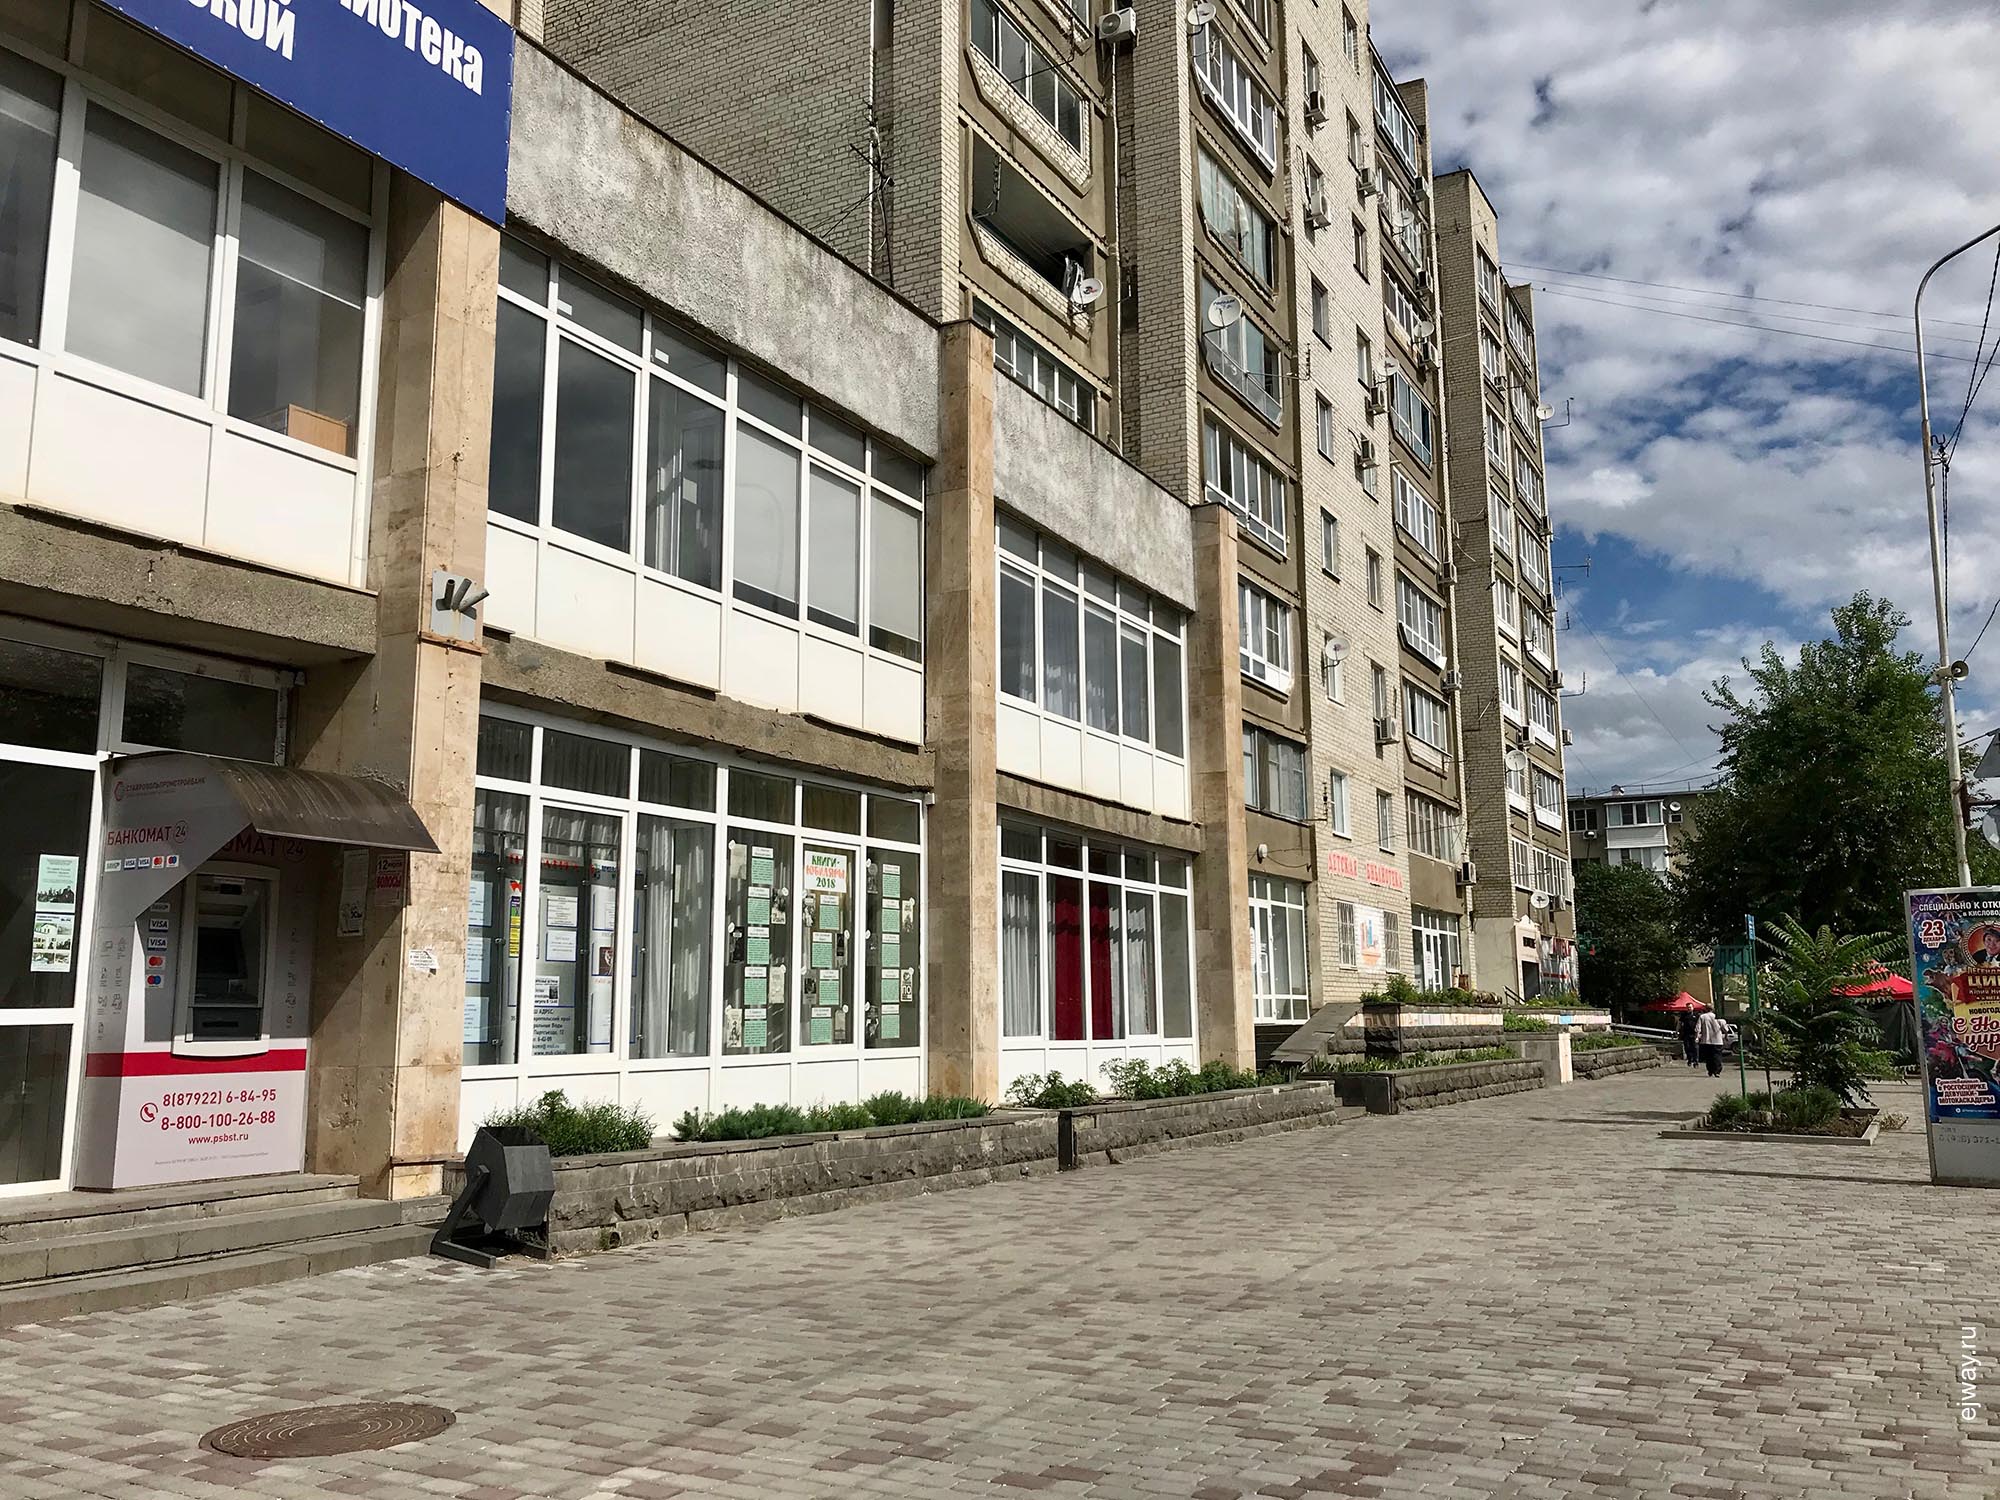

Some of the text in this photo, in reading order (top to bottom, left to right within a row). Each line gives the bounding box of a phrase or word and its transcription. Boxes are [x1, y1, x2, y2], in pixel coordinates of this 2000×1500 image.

[107, 825, 187, 846] БАНКОМАТ 24
[806, 865, 846, 879] ЮБИЛЯРЫ
[1328, 852, 1403, 889] ДЕТСКАЯ БИБЛИОТЕКА
[816, 877, 836, 889] 2018
[1919, 901, 1971, 911] СПЕЦИАЛЬНО
[152, 920, 168, 928] VISA
[1923, 921, 1944, 936] 23
[162, 1089, 276, 1107] 8(87922) 6-84-95
[161, 1110, 276, 1131] 8-800-100-26-88
[188, 1133, 249, 1145] www.psbst.ru
